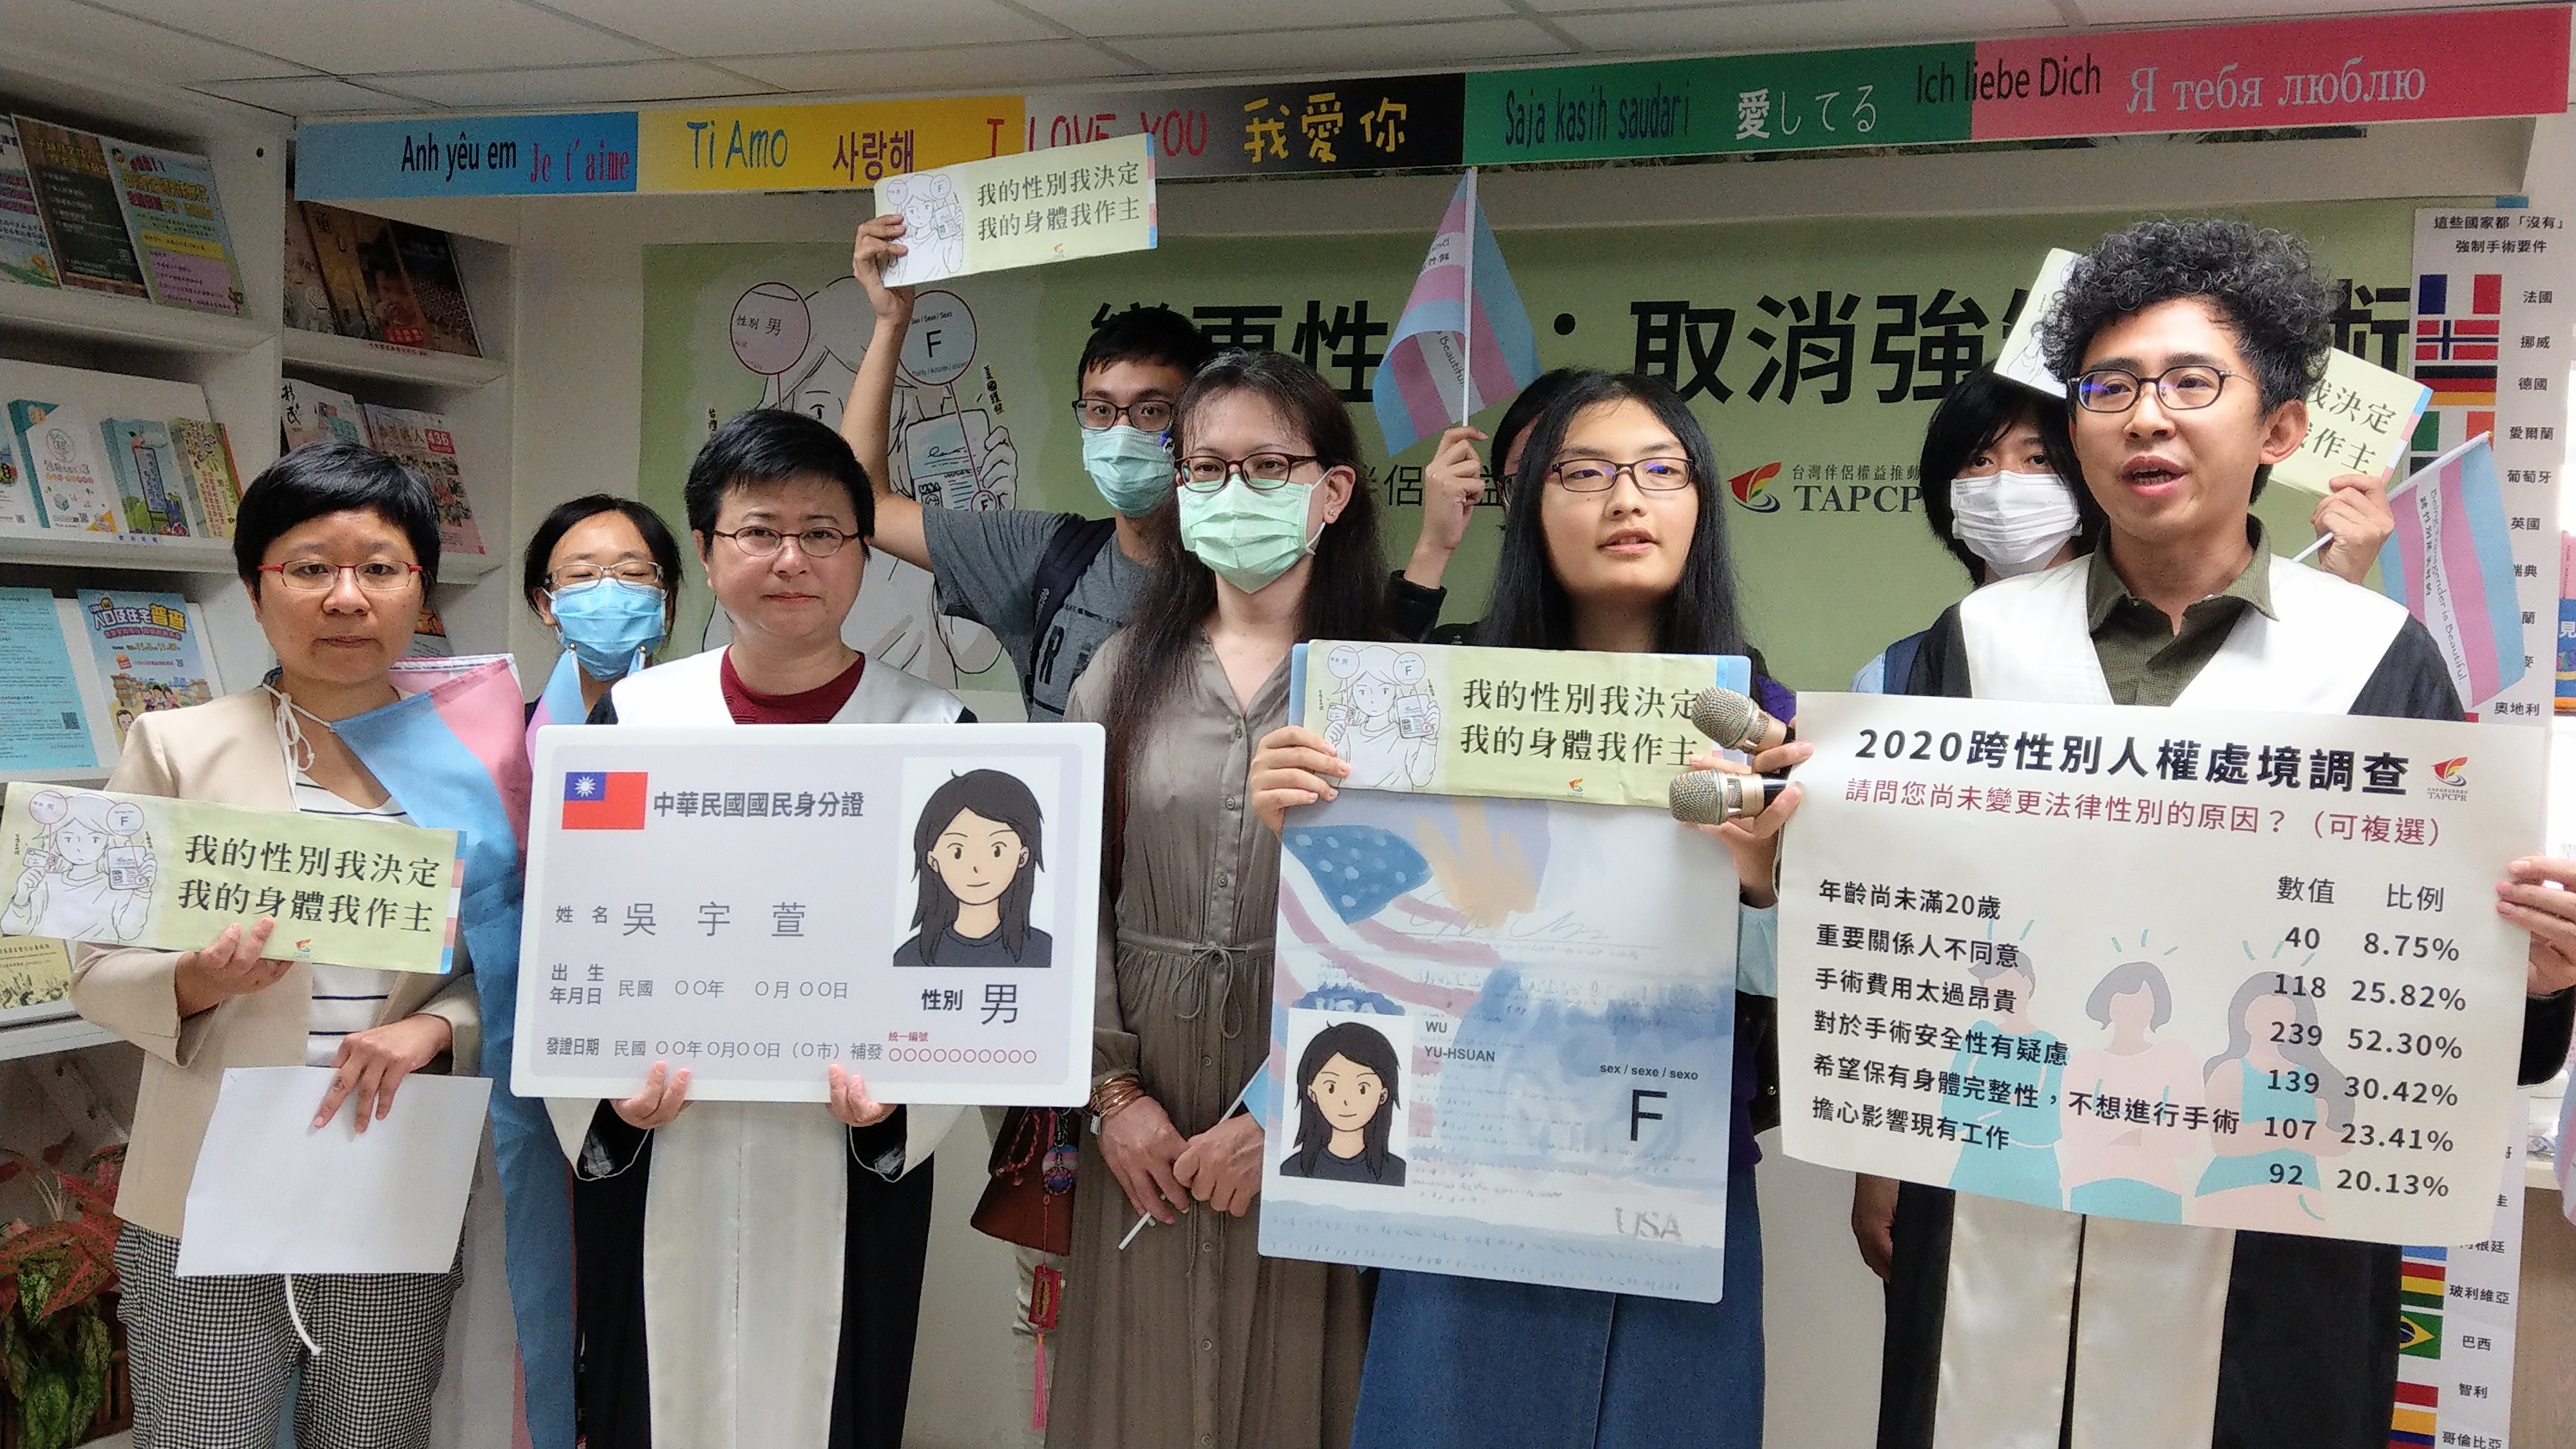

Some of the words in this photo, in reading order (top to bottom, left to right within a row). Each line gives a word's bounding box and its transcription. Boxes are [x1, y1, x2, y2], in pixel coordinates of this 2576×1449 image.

[1917, 62, 1955, 104] Ich
[1963, 58, 2031, 102] liebe
[2039, 53, 2102, 98] Dich
[2126, 68, 2157, 114] Я
[2172, 62, 2262, 111] тебя
[2277, 55, 2427, 107] люблю
[1244, 92, 1408, 164] 我愛你
[1505, 89, 1545, 149] Saja
[1555, 85, 1608, 142] kasih
[1617, 80, 1690, 141] saudari
[1738, 84, 1878, 142] 愛してる
[687, 120, 715, 169] Ti
[725, 120, 788, 169] Amo
[986, 117, 1005, 158] I
[401, 133, 439, 171] Anh
[446, 131, 479, 182] yêu
[488, 141, 516, 169] em
[529, 142, 552, 182] Je
[832, 129, 914, 182] 사랑해
[977, 161, 1139, 207] 我的性別我決定
[977, 195, 1141, 241] 我的身體我作主
[2434, 216, 2564, 229] 這些國家都「沒有」
[2456, 240, 2547, 254] 強制手術要件
[2523, 290, 2553, 304] 法國
[765, 317, 782, 337] 男
[927, 330, 942, 357] F
[2521, 335, 2550, 349] 挪威
[2519, 377, 2548, 391] 德國
[428, 430, 450, 445] 436
[2509, 426, 2554, 440] 愛爾蘭
[2507, 469, 2552, 484] 葡萄牙
[1793, 485, 1928, 513] TAPCP
[2511, 517, 2541, 531] 英國
[94, 603, 186, 632] 人口及住宅普查
[2521, 611, 2536, 624] 蘭
[2494, 701, 2540, 715] 奧地利
[1460, 723, 1698, 768] 我的身體我作主
[1855, 728, 2409, 796] 2020跨性別人權處境調查
[653, 791, 865, 818] 中華民國國民身分證
[2427, 792, 2467, 802] TAPCPR
[184, 833, 440, 889] 我的性別我決定
[177, 878, 434, 933] 我的身體我作主
[1818, 879, 2002, 920] 年齡尚未滿20歲
[2277, 875, 2336, 905] 數值
[2387, 883, 2445, 913] 比例
[1815, 923, 2020, 969] 重要關係人不同意
[2284, 926, 2321, 949] 40
[2363, 932, 2460, 961] 8.75%
[549, 987, 603, 1005] 年月日
[618, 979, 654, 998] 民國
[921, 988, 963, 1011] 性別
[980, 983, 1018, 1025] 男
[1814, 967, 2018, 1014] 手術費用太過昂貴
[2273, 973, 2327, 998] 118
[2351, 980, 2467, 1011] 25.82%
[1425, 1021, 1448, 1033] WU
[1813, 1010, 2069, 1068] 對於手術安全性有疑慮
[2269, 1021, 2324, 1046] 239
[2347, 1028, 2463, 1059] 52.30%
[546, 1037, 600, 1056] 發證日期
[614, 1039, 647, 1057] 民國
[1424, 1045, 1495, 1063] YU-HSUAN
[1599, 1063, 1620, 1075] sex
[1631, 1065, 1660, 1077] sexe
[1669, 1069, 1699, 1081] sexo
[2267, 1069, 2320, 1094] 139
[2344, 1075, 2458, 1106] 30.42%
[1630, 1089, 1668, 1142] F
[1812, 1095, 2010, 1151] 擔心影響現有工作
[2264, 1116, 2317, 1141] 107
[2340, 1122, 2454, 1153] 23.41%
[2269, 1162, 2304, 1186] 92
[2336, 1169, 2449, 1197] 20.13%
[1614, 1207, 1683, 1240] USA
[2449, 1283, 2510, 1305] 玻利維亞
[2462, 1334, 2492, 1351] 巴西
[2458, 1382, 2488, 1399] 智利
